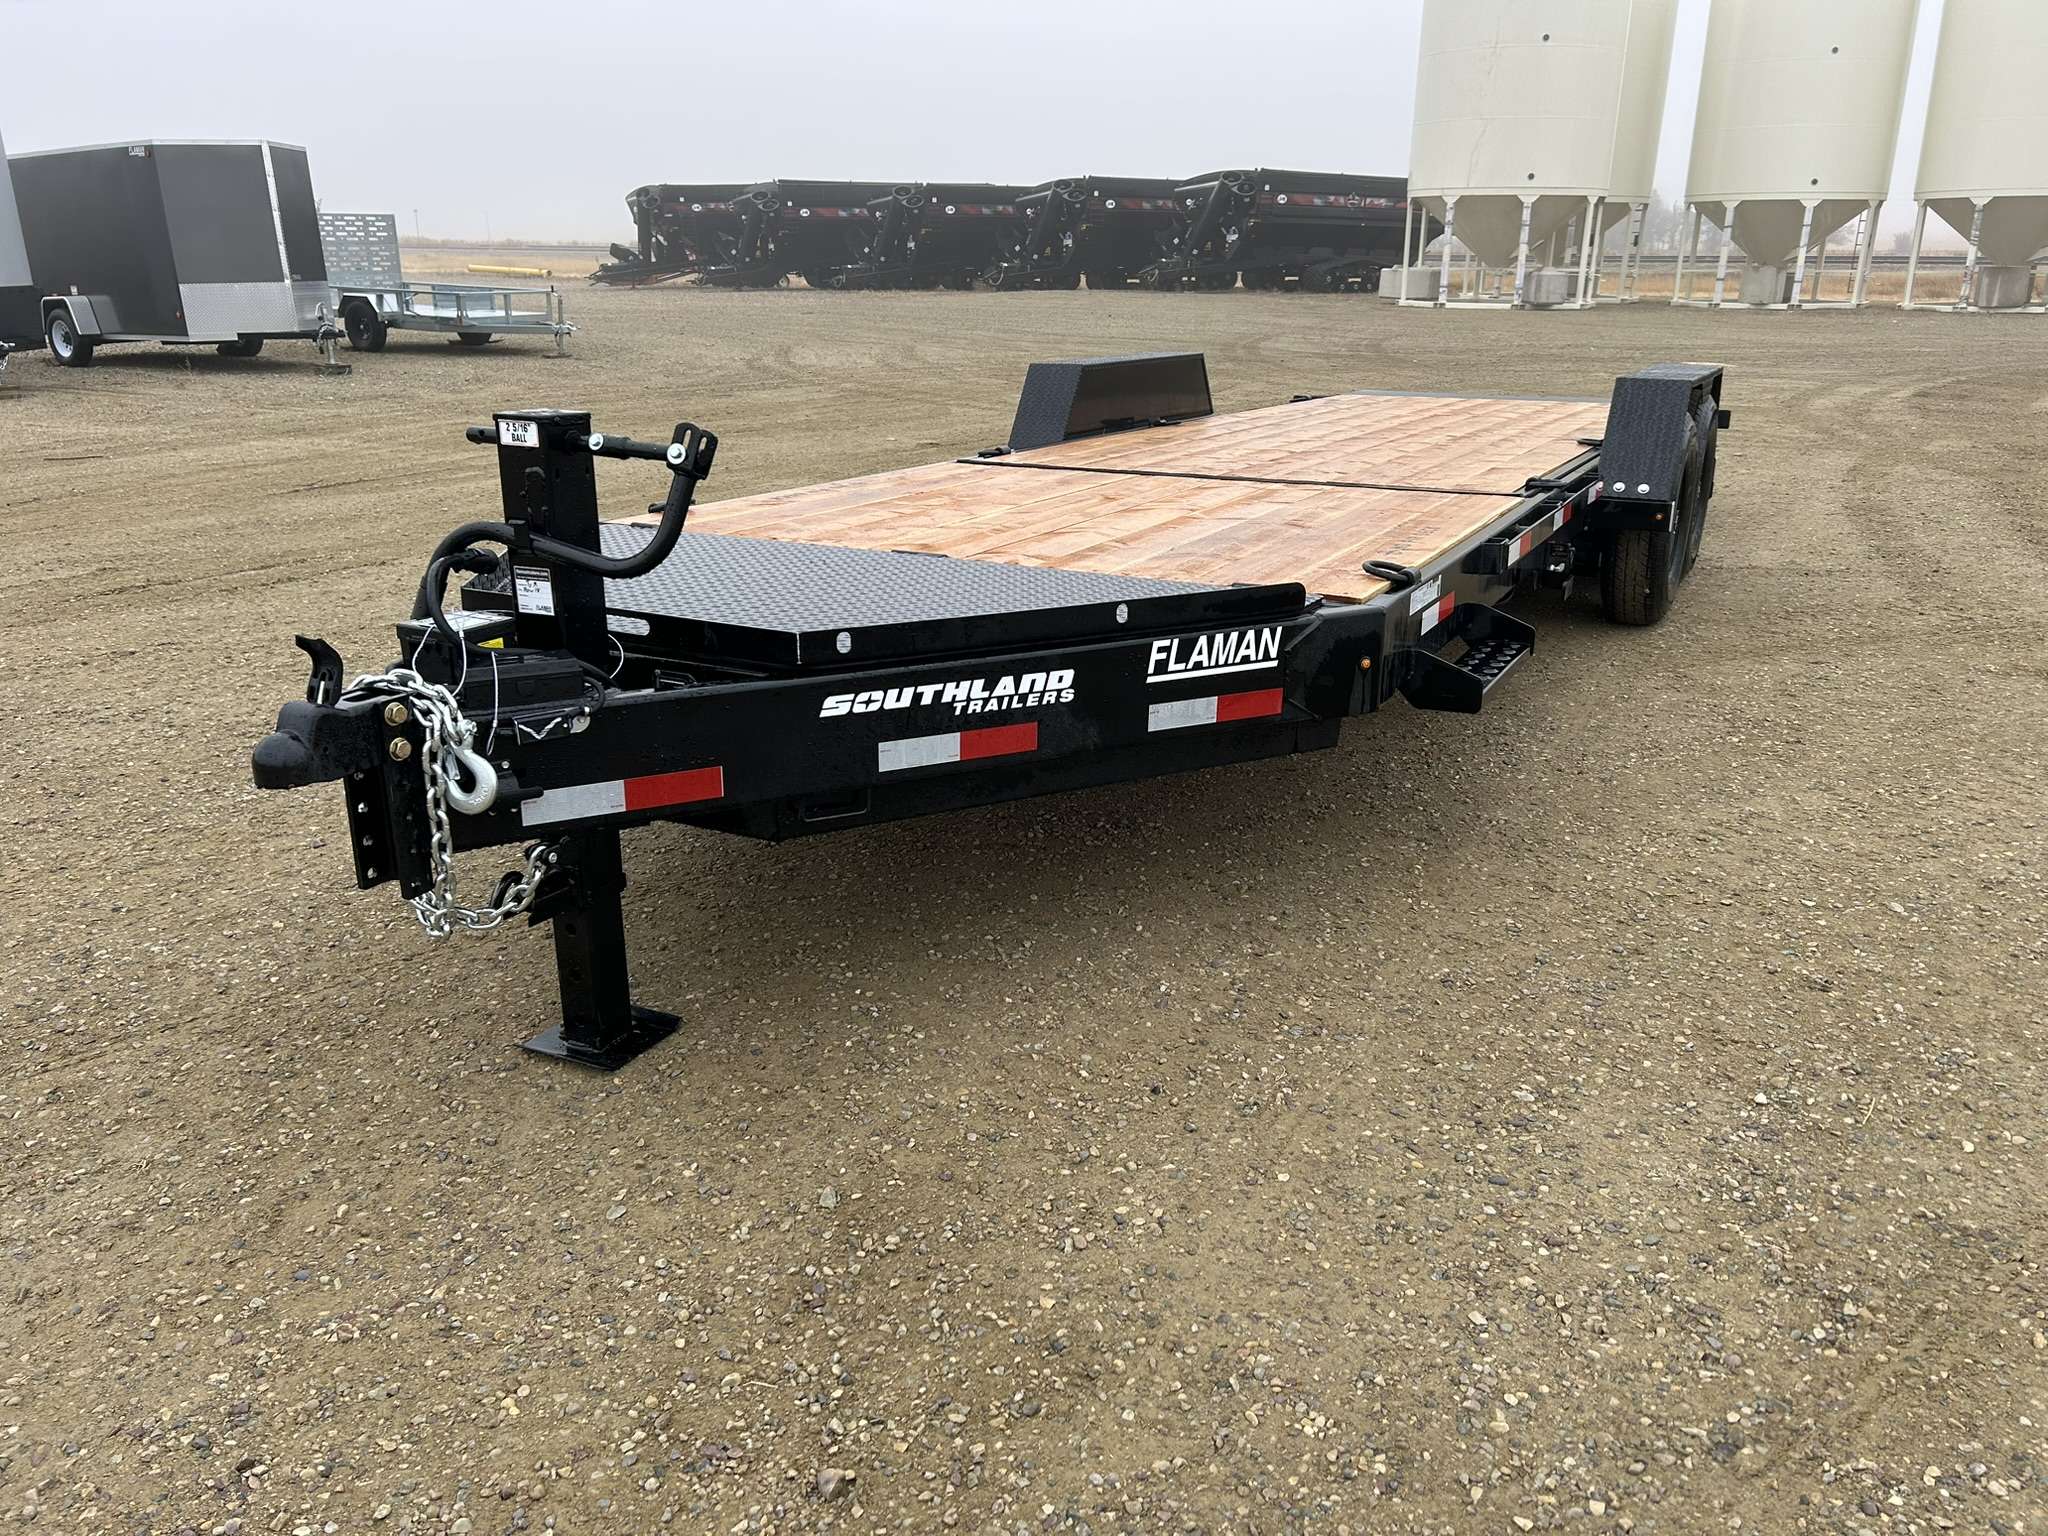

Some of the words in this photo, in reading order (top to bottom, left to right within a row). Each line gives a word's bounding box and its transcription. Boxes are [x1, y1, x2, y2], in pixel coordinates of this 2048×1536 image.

[505, 422, 511, 432] 2
[512, 422, 531, 433] 5/16"
[511, 432, 528, 443] BALL
[1147, 625, 1283, 675] FLAMAN
[818, 668, 1076, 718] SOUTHLAND
[952, 688, 1076, 716] TRAILERS
